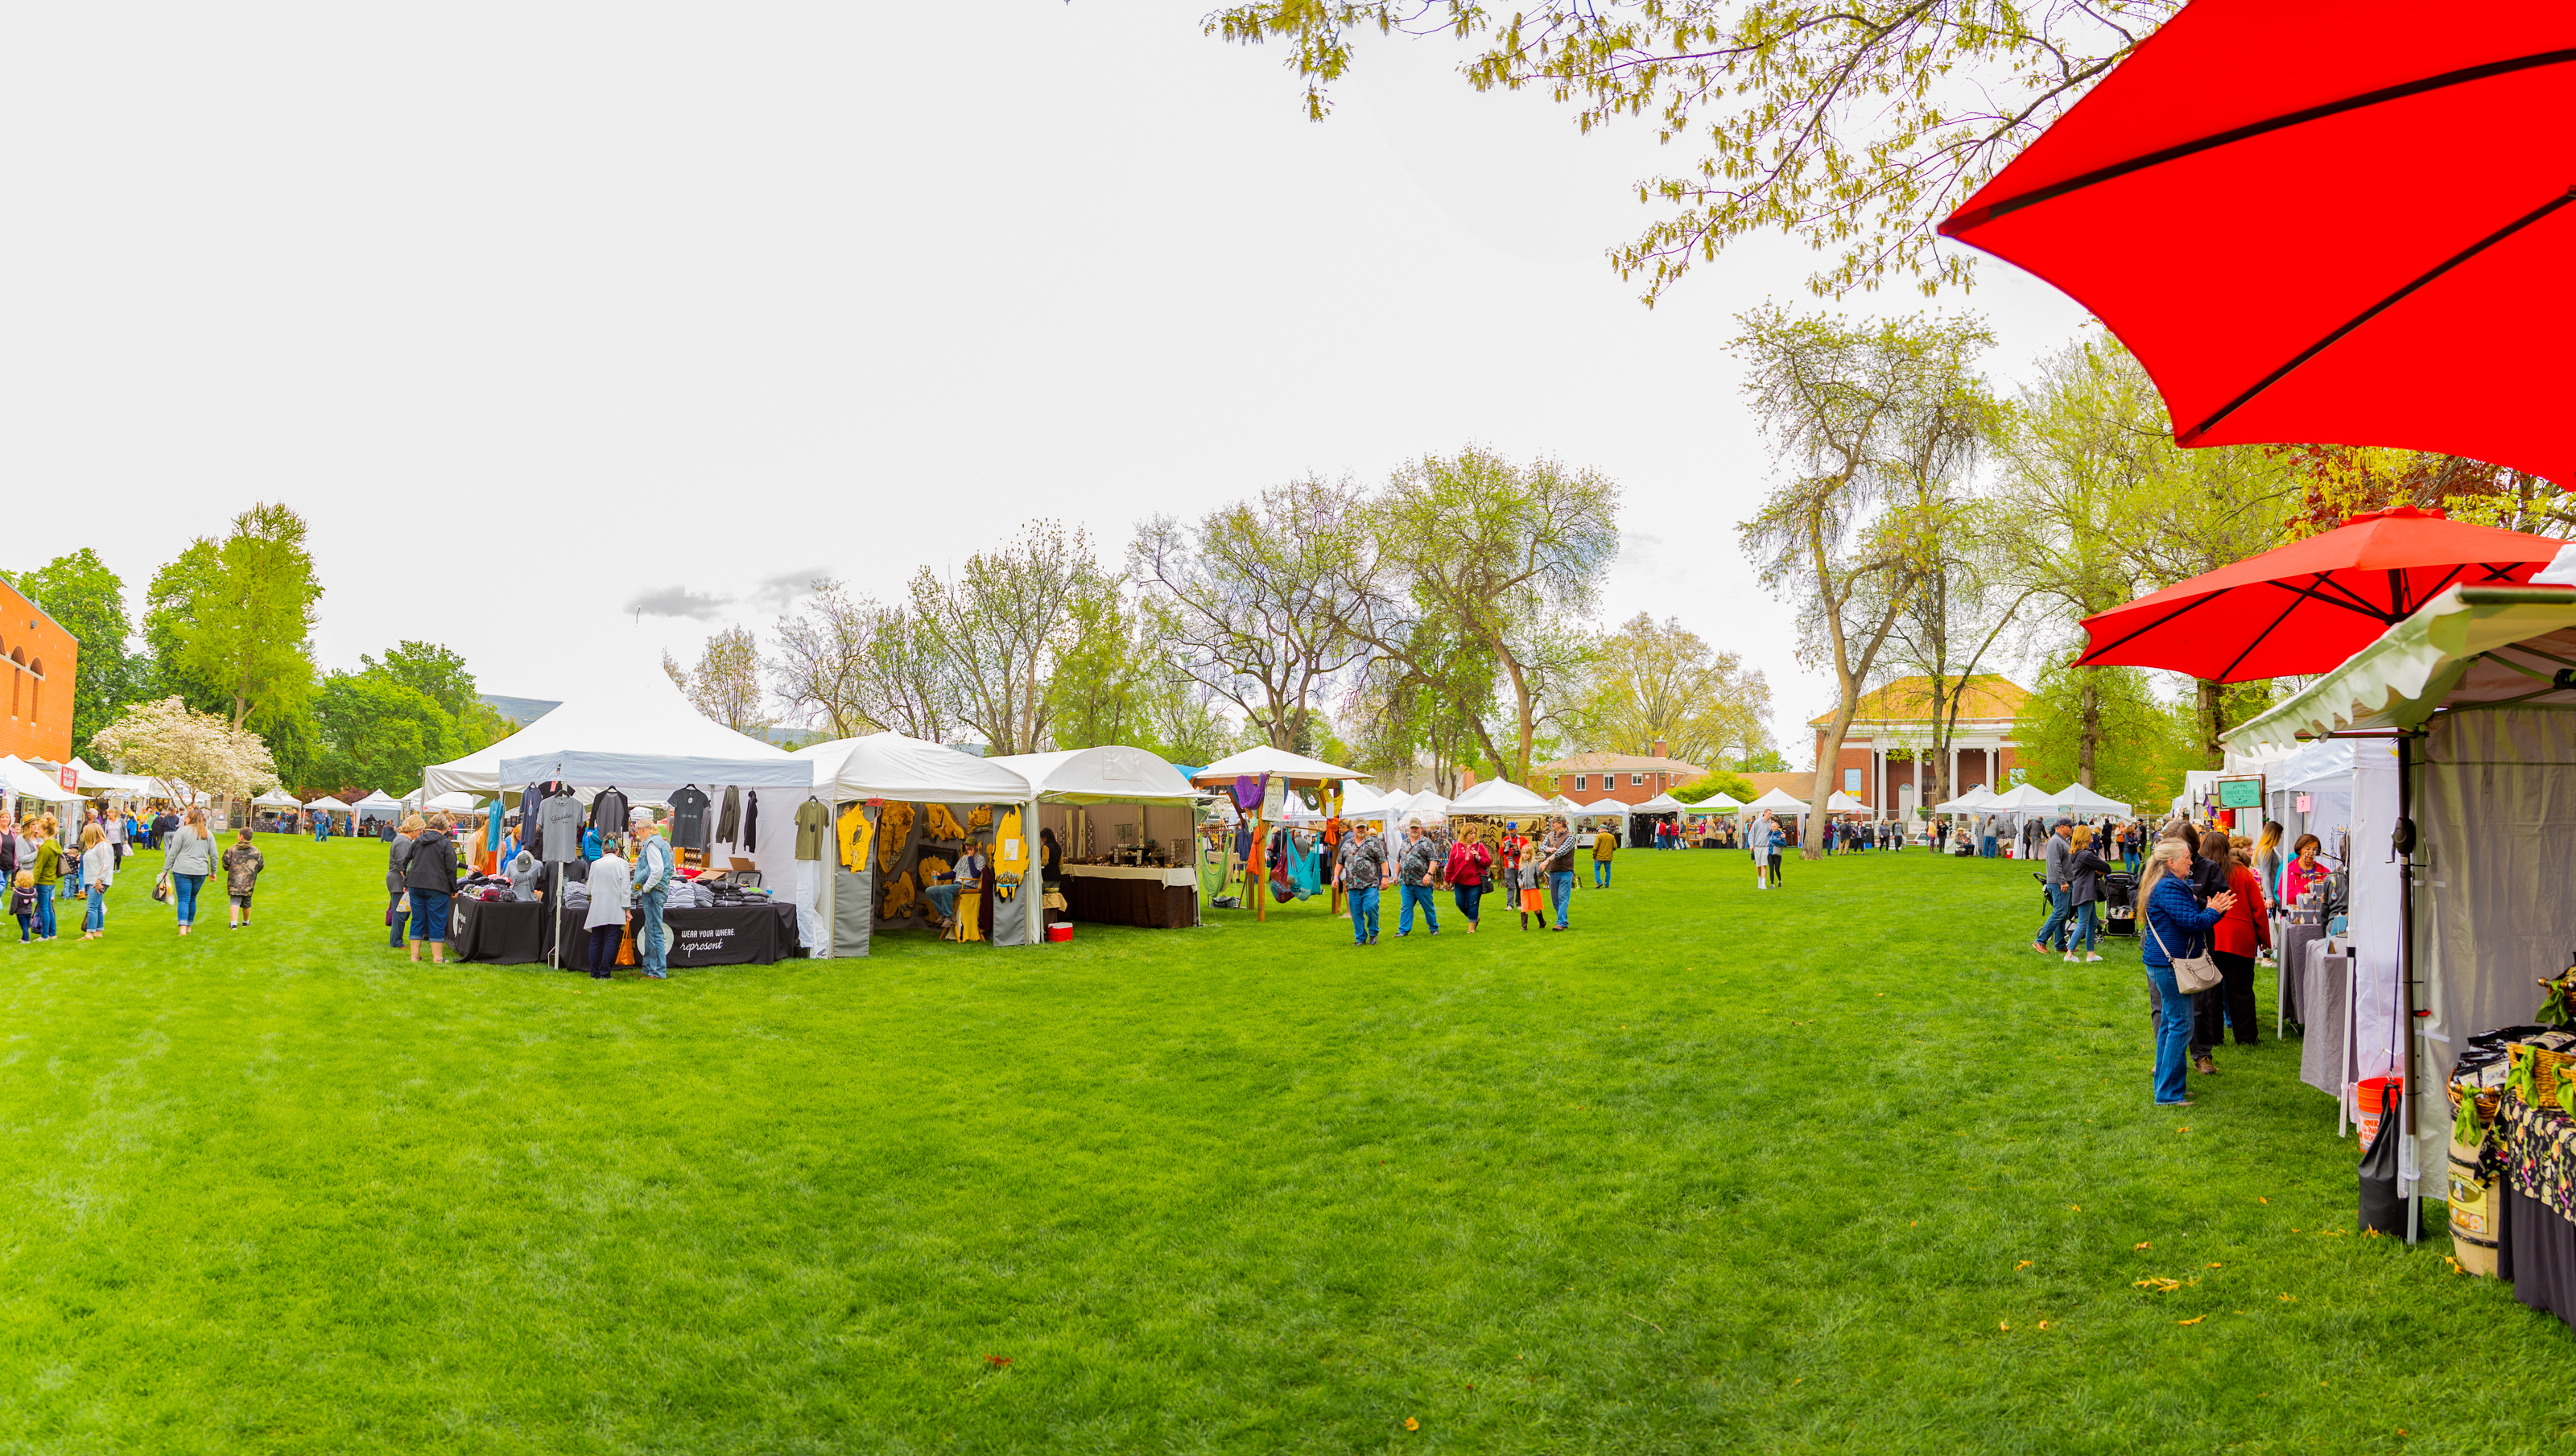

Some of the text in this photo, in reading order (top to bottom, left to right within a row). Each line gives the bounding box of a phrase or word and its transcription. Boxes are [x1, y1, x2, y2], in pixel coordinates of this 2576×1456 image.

[2301, 800, 2305, 808] 7
[699, 930, 714, 938] YOUR
[715, 928, 736, 937] WHERE.
[679, 938, 724, 958] represent
